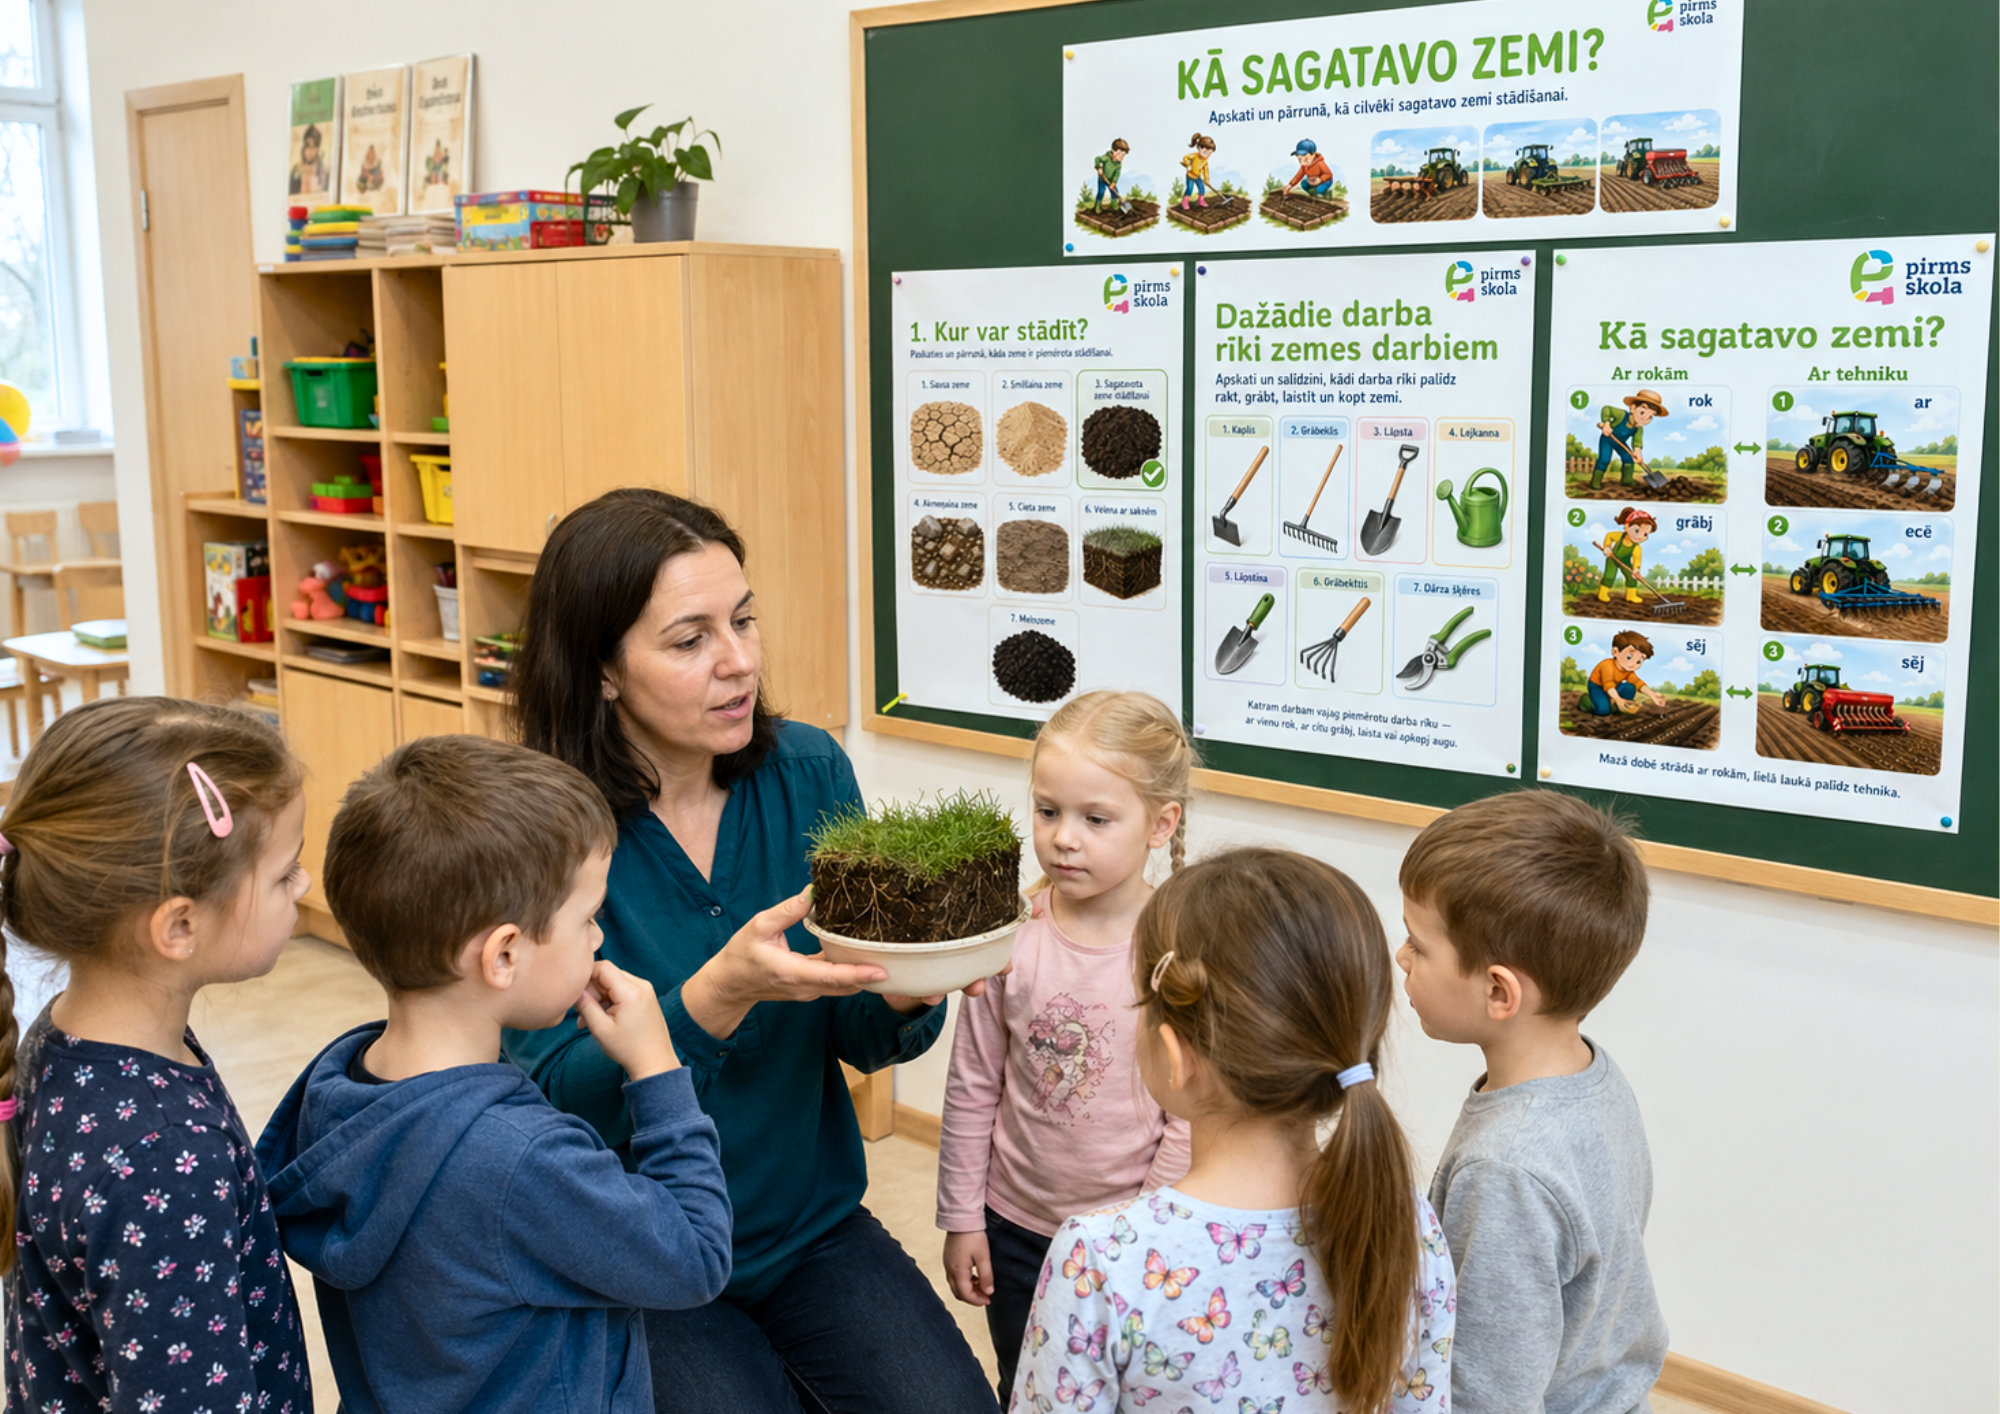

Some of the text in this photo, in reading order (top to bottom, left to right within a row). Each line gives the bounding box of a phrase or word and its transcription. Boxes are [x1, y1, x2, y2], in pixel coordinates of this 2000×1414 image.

[1679, 0, 1718, 14] pirms
[1679, 11, 1714, 26] skola
[1177, 28, 1606, 100] KĀ SAGATAVO ZEMI?
[1208, 107, 1255, 126] Apskati
[1258, 108, 1274, 121] un
[1277, 103, 1331, 122] pārrunā,
[1334, 101, 1350, 116] kā
[1353, 97, 1395, 115] cilvēki
[1398, 97, 1457, 114] sagatavo
[1460, 91, 1493, 108] zemi
[1905, 257, 1971, 278] pirms
[1481, 268, 1521, 283] pirms
[1133, 280, 1171, 294] pirms
[1481, 281, 1518, 296] skola
[1905, 277, 1963, 296] skola
[1133, 294, 1169, 308] skola
[1216, 298, 1433, 330] Dažādie darba
[909, 317, 1090, 343] 1. Kur var stādīt?
[1599, 316, 1946, 357] Kā sagatavo zemi?
[1216, 332, 1499, 362] rīki zemes darbiem
[1215, 373, 1258, 388] Apskati
[1260, 376, 1274, 385] un
[1330, 373, 1355, 385] kādi
[1358, 373, 1393, 385] darba
[1611, 366, 1689, 381] Ar rokām
[1807, 366, 1909, 381] Ar tehniku
[921, 380, 929, 390] 1.
[951, 382, 971, 391] zeme
[1002, 380, 1009, 390] 2.
[1044, 381, 1064, 390] zeme
[1215, 390, 1241, 404] rakt,
[1245, 390, 1279, 405] grābt,
[1320, 393, 1334, 403] un
[1338, 390, 1366, 406] kopt
[1369, 390, 1402, 403] zemi.
[1688, 395, 1713, 407] rok
[1914, 399, 1932, 409] ar
[1222, 425, 1230, 435] 1.
[1290, 425, 1299, 436] 2.
[1373, 426, 1382, 437] 3.
[1448, 427, 1458, 438] 4.
[960, 501, 979, 510] zeme
[1009, 501, 1017, 512] 5.
[1085, 504, 1093, 514] 6.
[1676, 515, 1713, 531] grābj
[1905, 525, 1932, 538] ecē
[1224, 571, 1233, 581] 5.
[1313, 577, 1322, 587] 6.
[1413, 582, 1422, 592] 7.
[1010, 613, 1018, 624] 7.
[1686, 640, 1706, 655] sēj
[1901, 655, 1925, 673] sēj
[1247, 700, 1280, 712] Katram
[1281, 704, 1315, 716] darbam
[1316, 708, 1341, 721] vajag
[1342, 710, 1388, 723] piemērotu
[1390, 715, 1418, 727] darba
[1245, 717, 1255, 725] ar
[1257, 717, 1279, 728] vienu
[1281, 719, 1298, 731] rok,
[1300, 723, 1310, 731] ar
[1311, 722, 1328, 733] citu
[1358, 727, 1382, 739] laista
[1384, 731, 1398, 740] vai
[1432, 737, 1458, 749] augu.
[1599, 753, 1627, 766] Mazā
[1631, 757, 1657, 770] dobē
[1660, 761, 1694, 774] strādā
[1697, 767, 1709, 775] ar
[1712, 767, 1750, 782] rokām,
[1753, 770, 1777, 784] lielā
[1780, 774, 1812, 788] laukā
[1853, 783, 1902, 799] tehnika.
